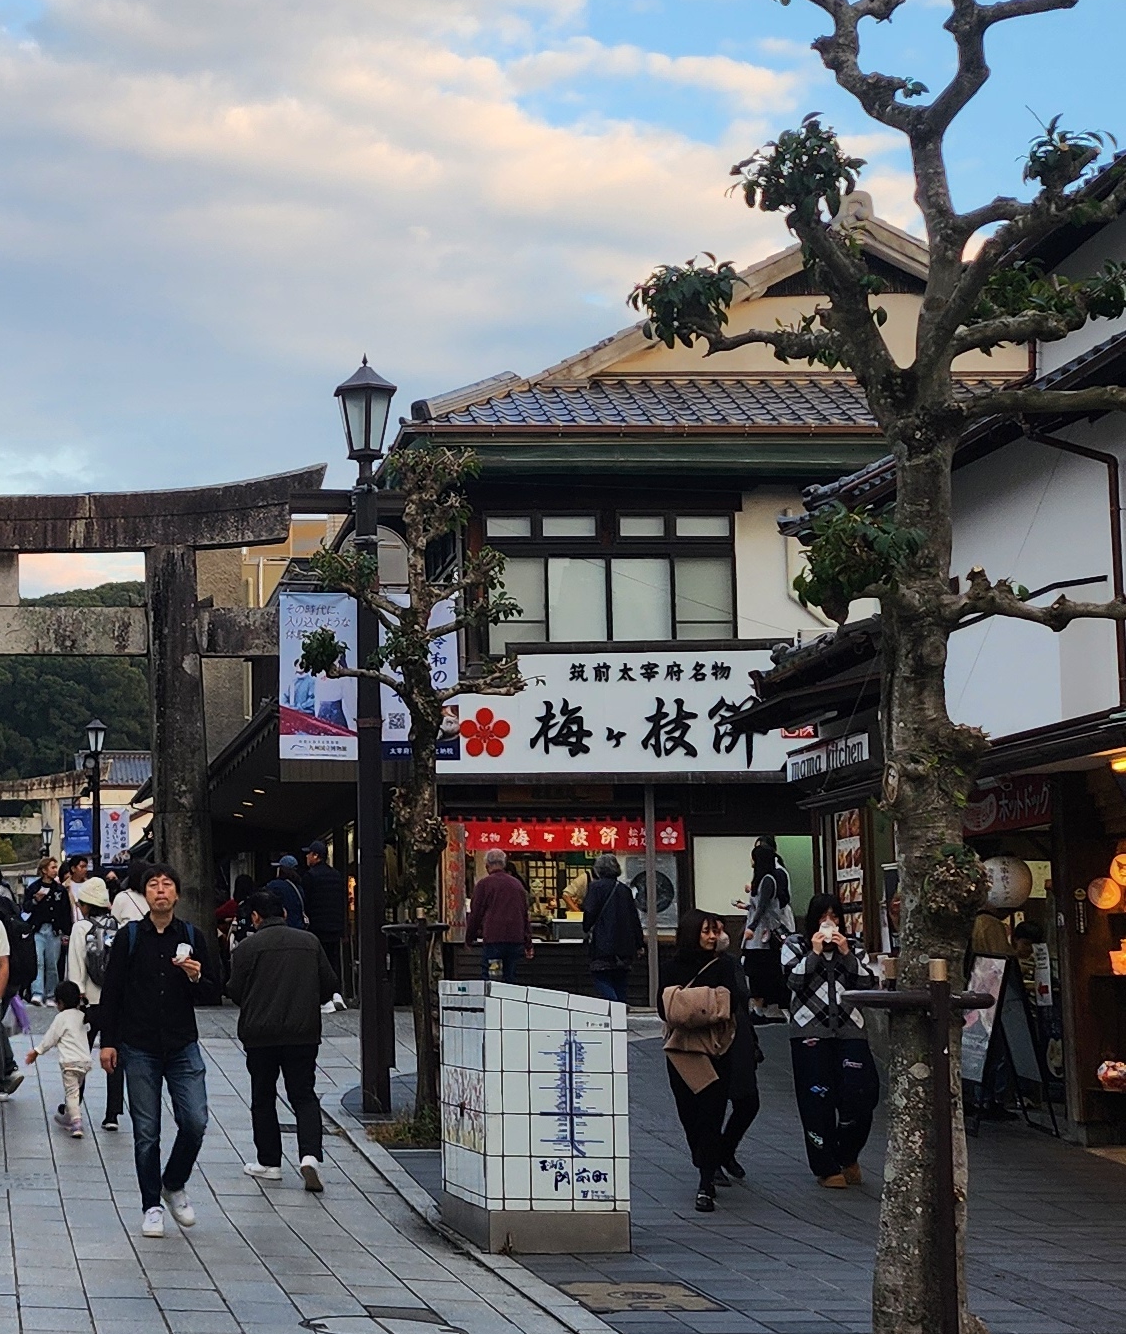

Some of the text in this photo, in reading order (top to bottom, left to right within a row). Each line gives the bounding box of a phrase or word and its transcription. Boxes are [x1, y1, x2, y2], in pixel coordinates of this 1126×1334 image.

[431, 636, 448, 691] 令和の
[569, 661, 732, 683] 筑前太宰府名物
[791, 737, 864, 781] mama kitchen
